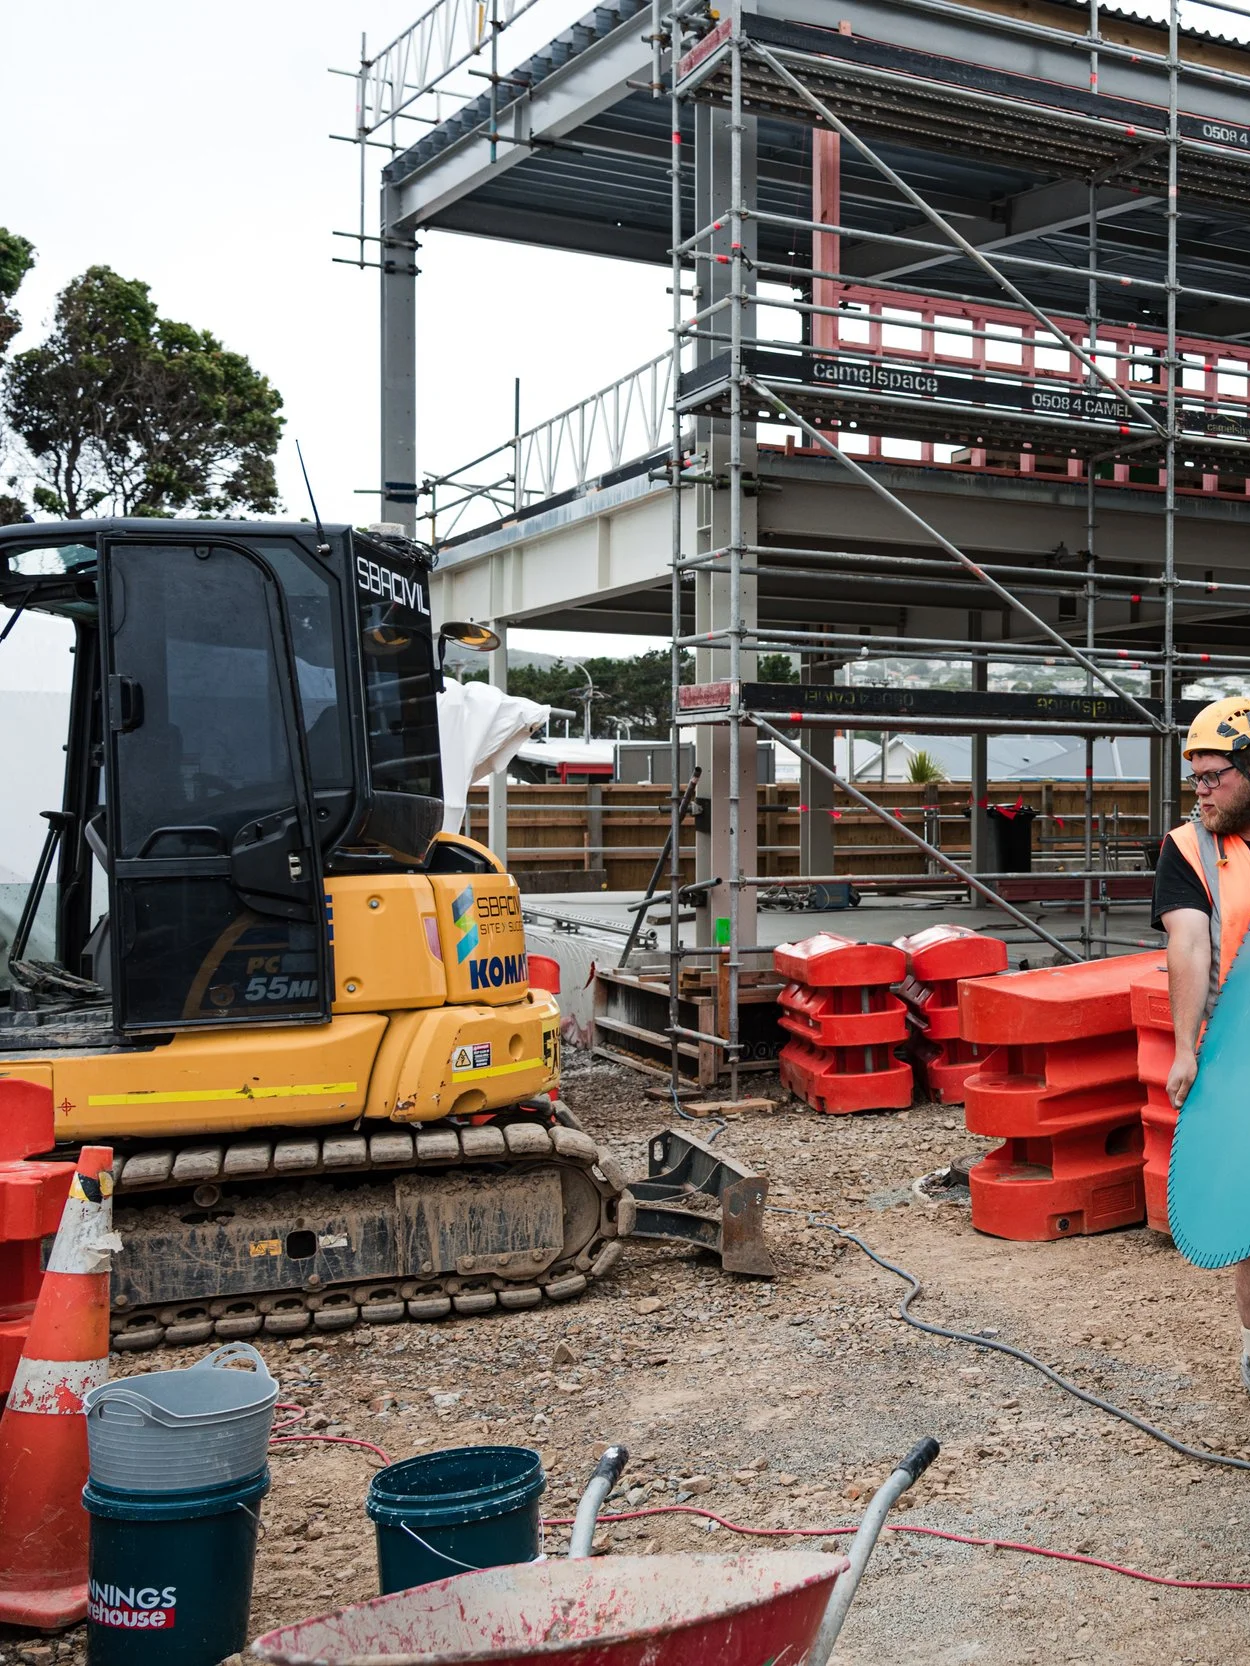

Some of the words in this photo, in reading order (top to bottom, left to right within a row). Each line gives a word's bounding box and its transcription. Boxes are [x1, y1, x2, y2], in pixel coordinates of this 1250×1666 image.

[1203, 124, 1238, 142] 0508
[1240, 133, 1248, 145] 4
[814, 363, 938, 392] camelspace
[1032, 393, 1070, 410] 0508
[1073, 398, 1082, 412] 4
[1085, 399, 1133, 418] CAMEL
[246, 955, 281, 975] PC
